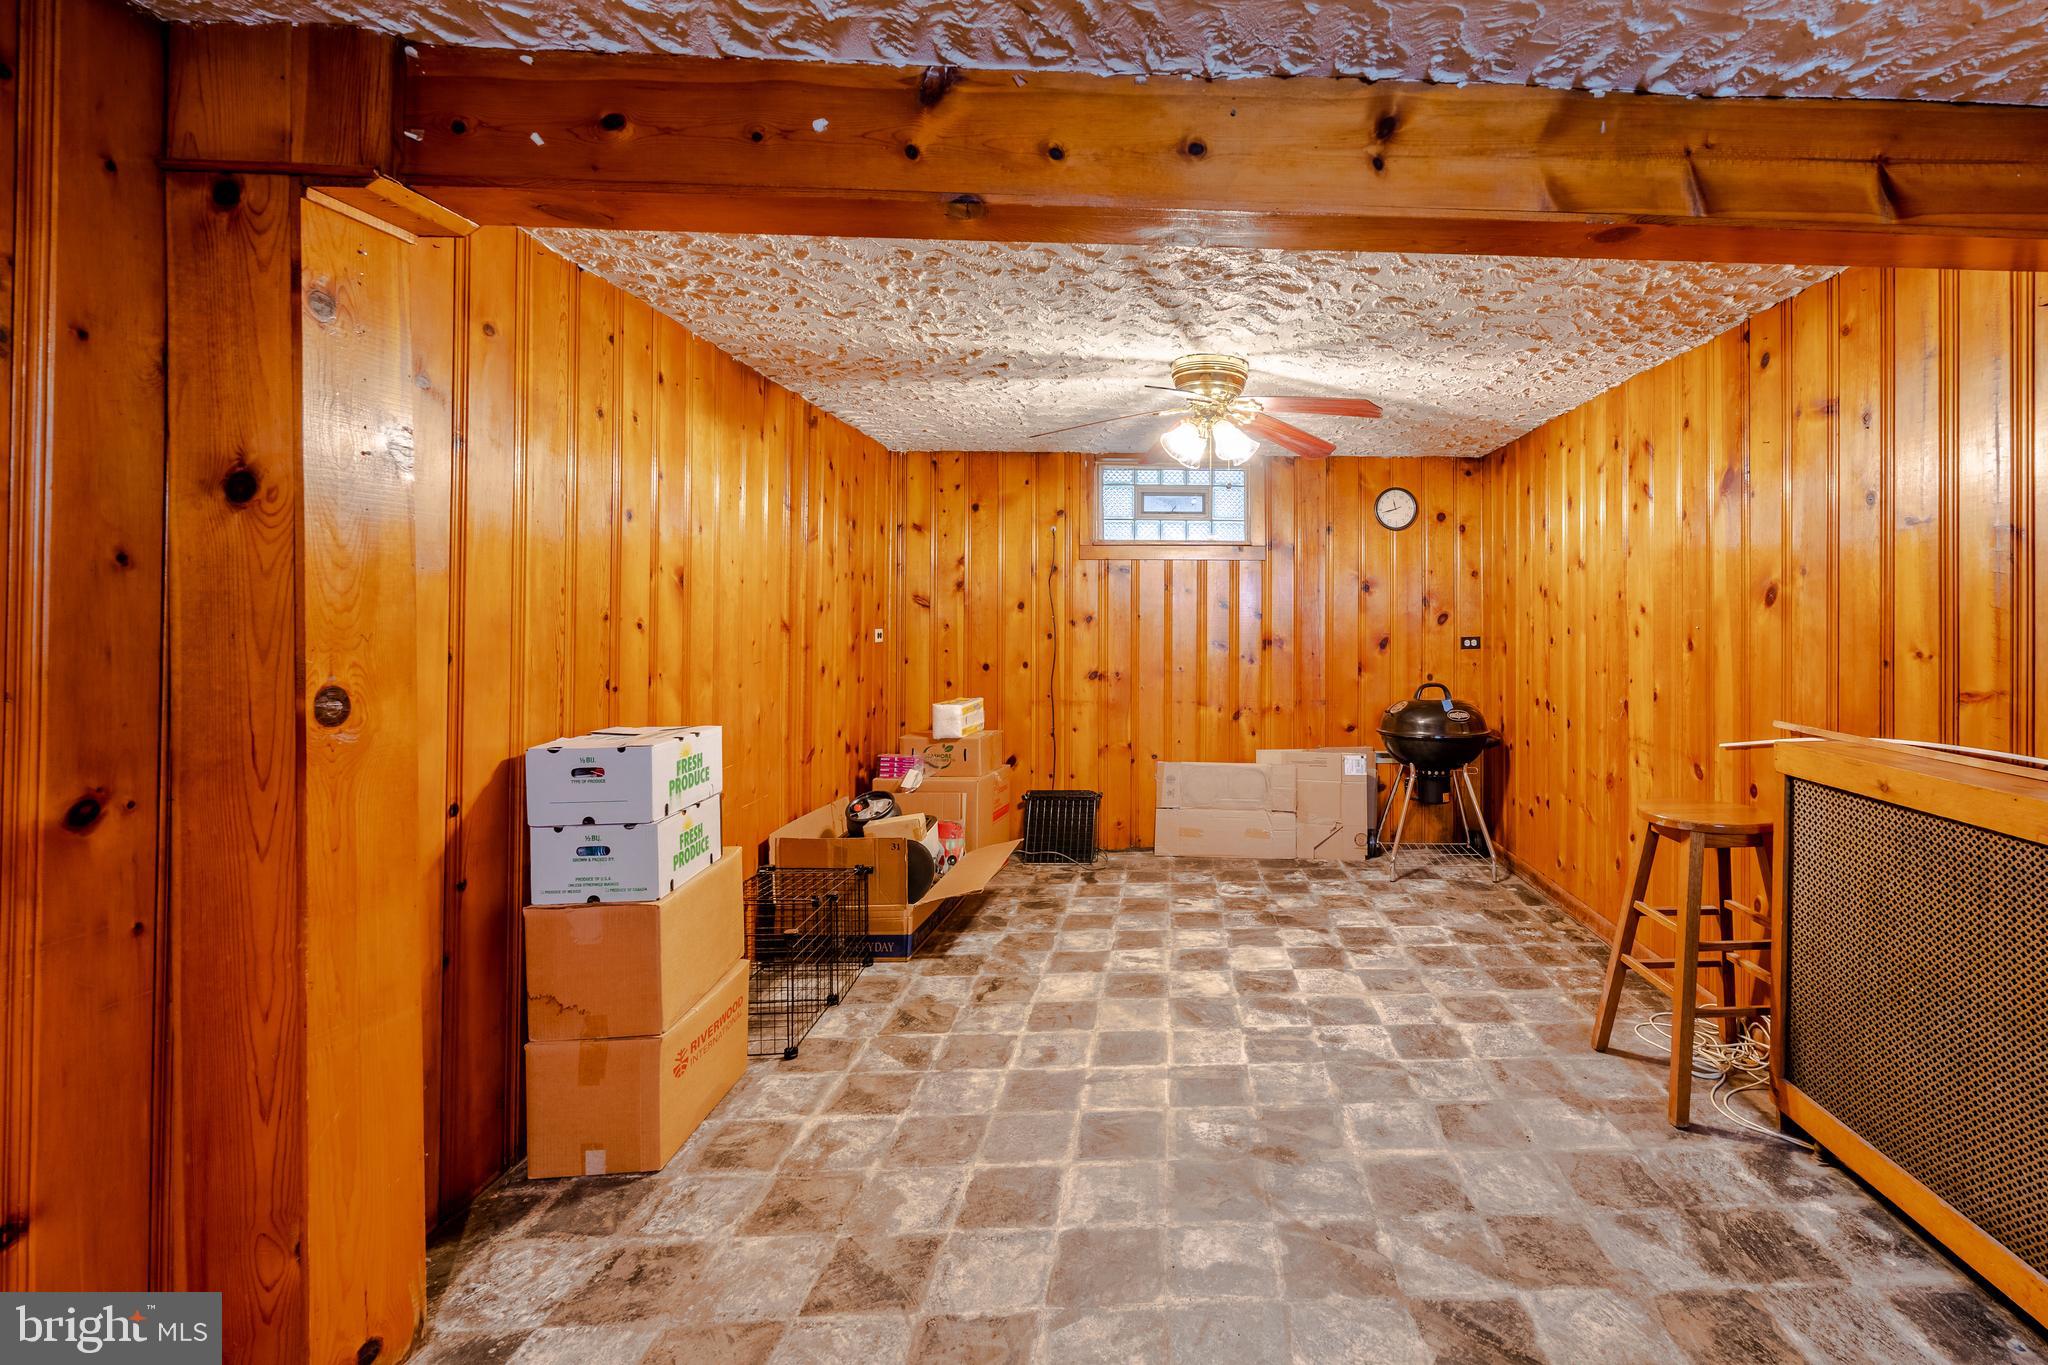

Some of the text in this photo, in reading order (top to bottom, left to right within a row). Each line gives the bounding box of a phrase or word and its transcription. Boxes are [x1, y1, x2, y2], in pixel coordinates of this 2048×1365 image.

[676, 752, 703, 776] FRESH
[669, 766, 710, 797] PRODUCE
[680, 822, 703, 850] FRESH
[890, 842, 900, 851] 31
[673, 835, 710, 872] PRODUCE
[690, 996, 744, 1054] RIVERWOOD
[690, 1011, 742, 1066] INTERNATIONAL
